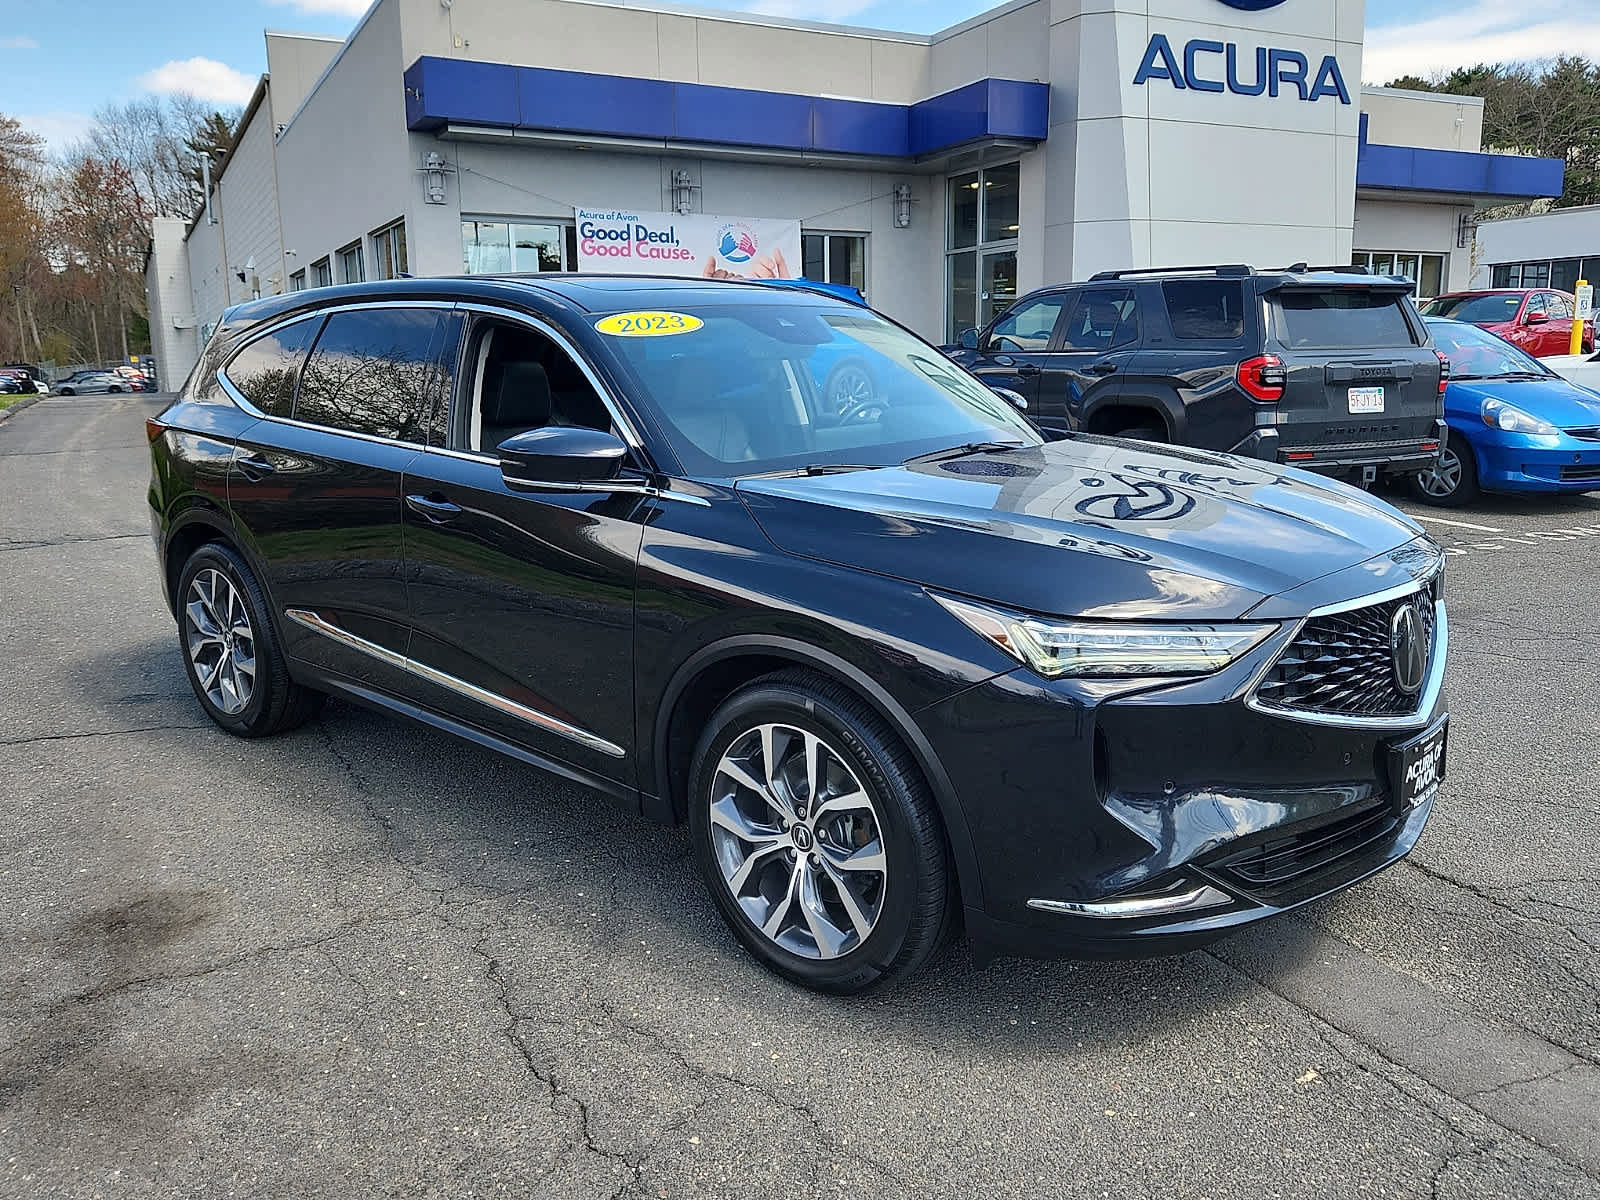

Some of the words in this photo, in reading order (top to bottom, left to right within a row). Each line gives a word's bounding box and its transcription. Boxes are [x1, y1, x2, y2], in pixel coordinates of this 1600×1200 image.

[1133, 33, 1351, 105] ACURA
[579, 210, 604, 219] Acura
[606, 212, 615, 220] of
[616, 213, 639, 221] Avon
[580, 222, 630, 241] Good
[636, 224, 680, 247] Deal,
[581, 238, 631, 257] Good
[636, 241, 695, 260] Cause.
[617, 315, 686, 333] 2023
[1360, 368, 1392, 377] TOYOTA
[1405, 750, 1434, 784] ACURA
[1434, 740, 1443, 762] OF
[1413, 762, 1437, 794] AVON
